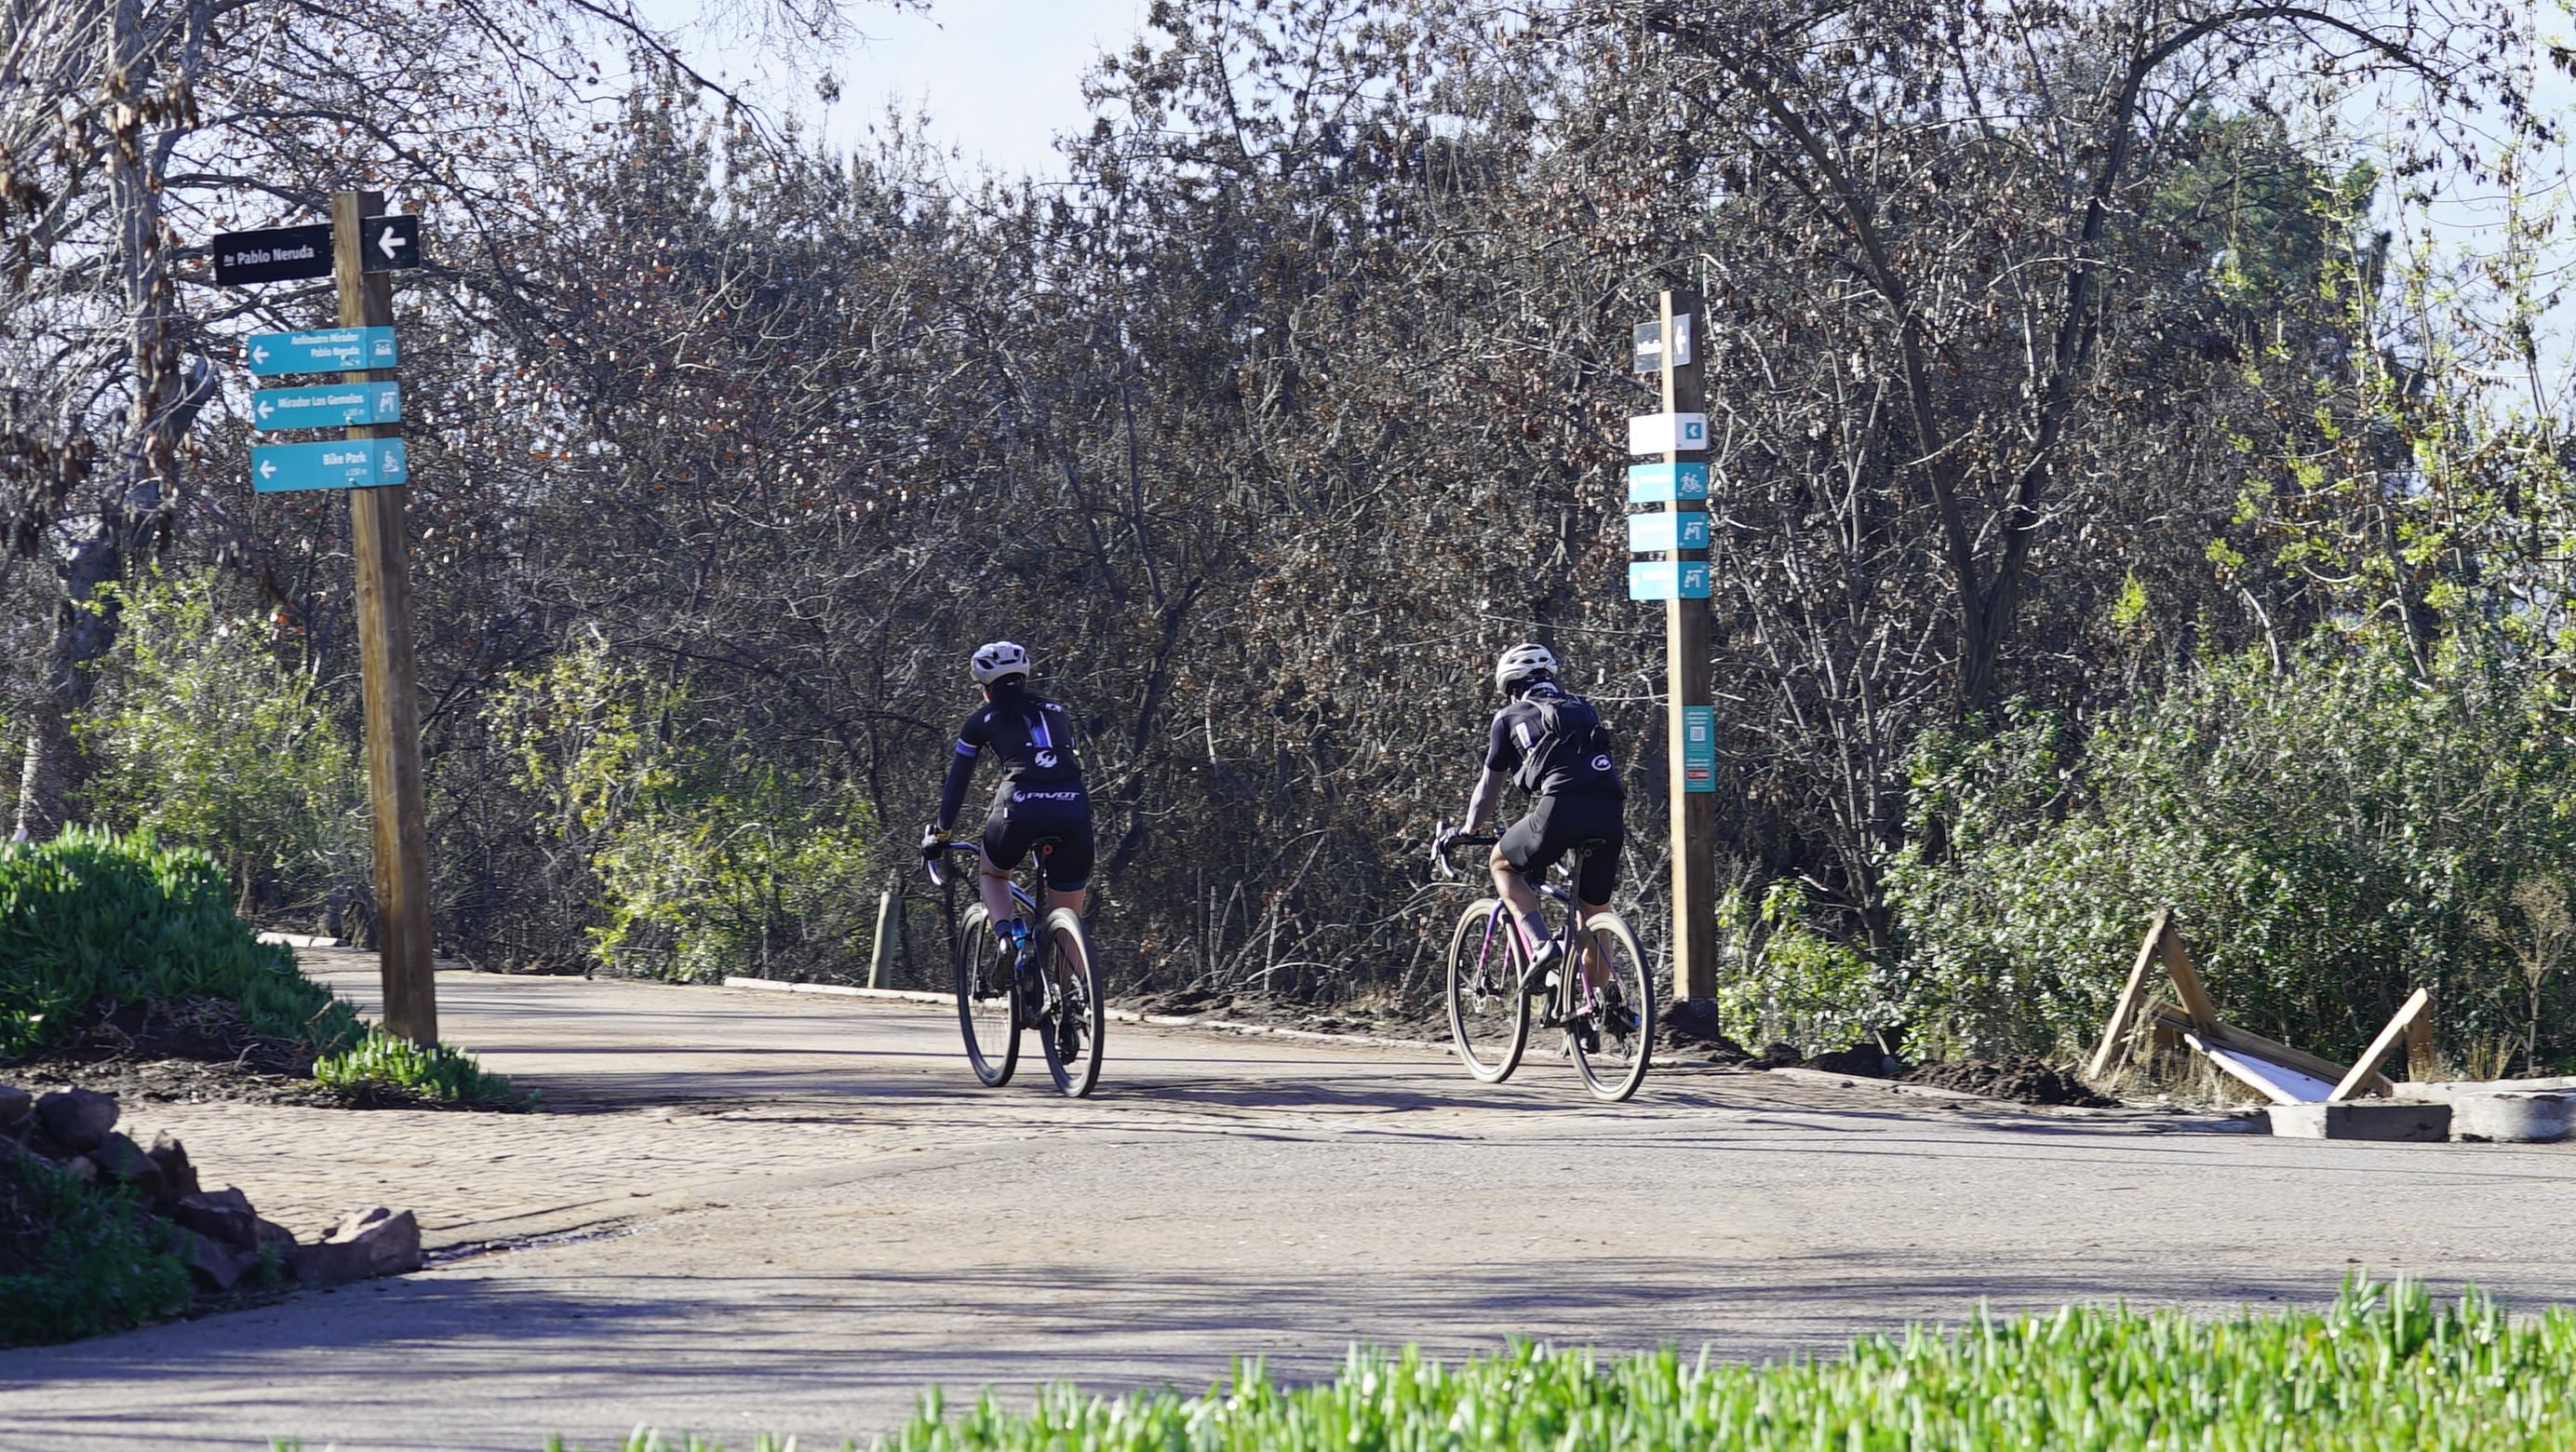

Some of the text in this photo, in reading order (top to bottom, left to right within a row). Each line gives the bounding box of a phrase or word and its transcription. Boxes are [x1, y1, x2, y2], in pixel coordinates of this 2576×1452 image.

[237, 249, 270, 265] Pablo
[272, 245, 315, 262] Neruda
[277, 396, 311, 409] Mirador
[312, 395, 327, 407] Los
[322, 450, 368, 465] Bike Park
